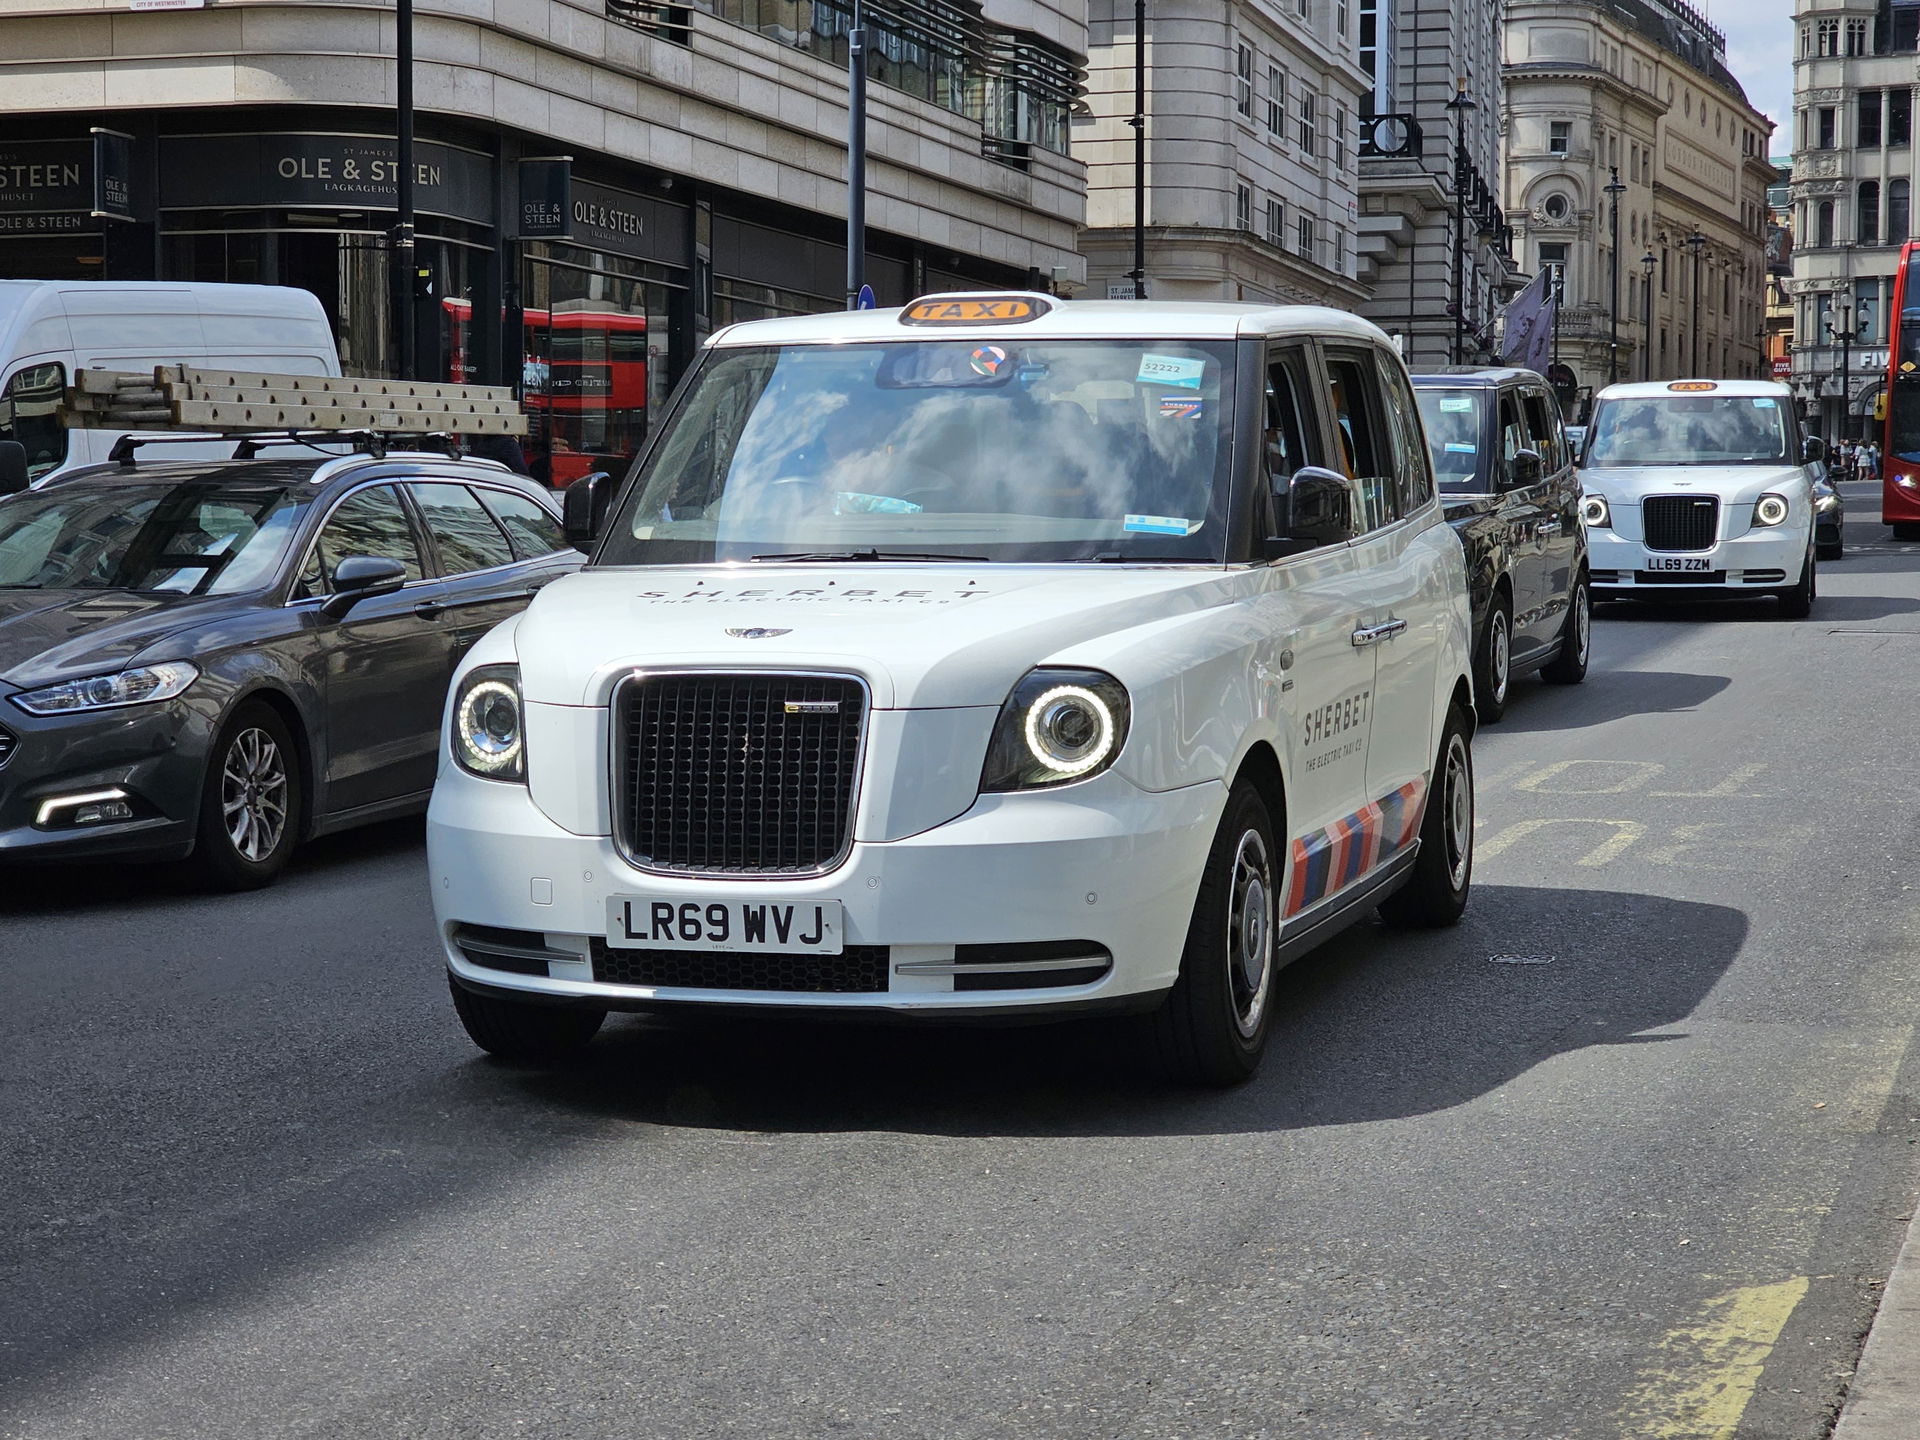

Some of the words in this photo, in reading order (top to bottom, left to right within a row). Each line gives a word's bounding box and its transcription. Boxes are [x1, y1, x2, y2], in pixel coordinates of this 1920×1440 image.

[278, 157, 332, 179] OLE
[342, 158, 361, 181] &
[370, 160, 441, 186] STEN
[105, 179, 120, 191] OLE
[105, 190, 128, 204] STEEN
[524, 203, 546, 213] OLE
[552, 203, 560, 213] &
[26, 217, 36, 228] &
[39, 216, 81, 228] STEEN
[525, 214, 560, 224] STEEN
[574, 200, 596, 226] OLE
[599, 207, 607, 228] &
[609, 209, 643, 236] STEEN
[923, 303, 1018, 318] TAXI
[1860, 351, 1891, 367] FIV
[1143, 362, 1181, 374] 52222
[1648, 558, 1682, 571] LL69
[1685, 558, 1710, 571] ZZM
[636, 589, 990, 599] SHERBET
[1304, 691, 1369, 747] SHERBET
[1305, 757, 1317, 773] THE
[1317, 747, 1342, 769] ELECTRIC
[1343, 742, 1355, 757] TAXI
[624, 901, 730, 942] LR69
[742, 904, 823, 945] WVJ
